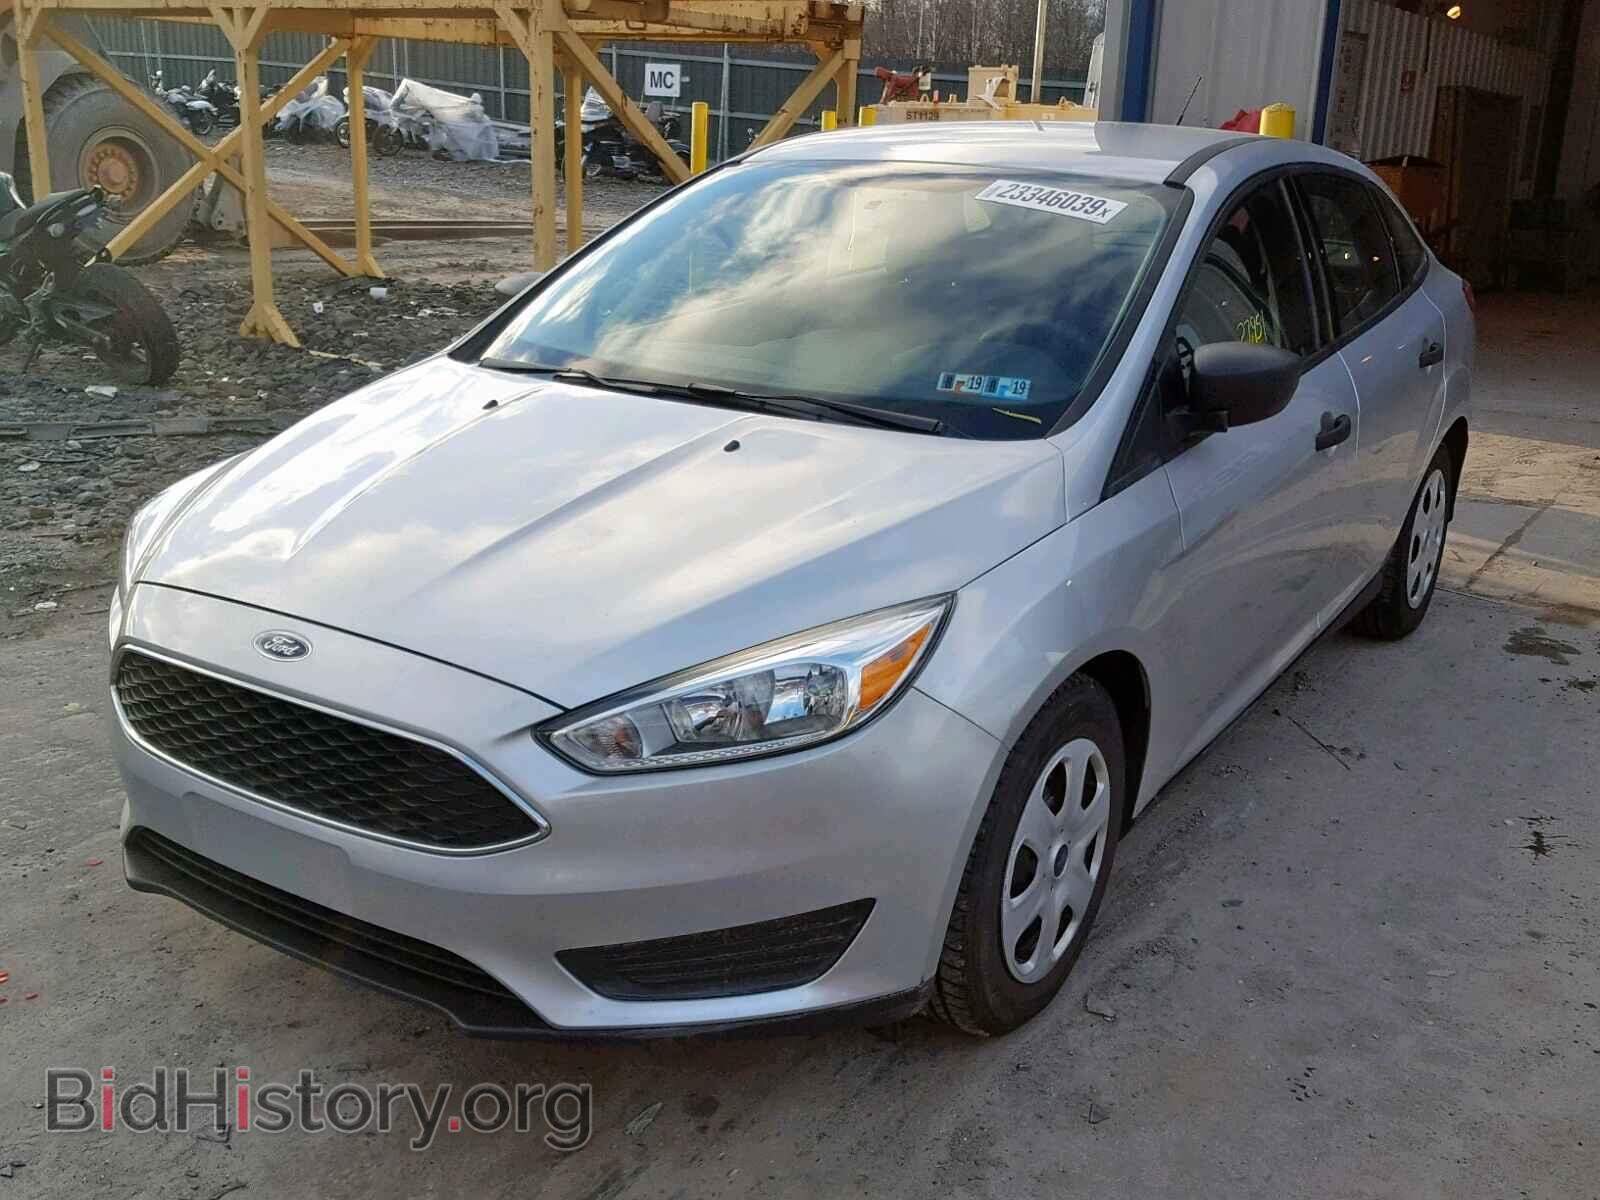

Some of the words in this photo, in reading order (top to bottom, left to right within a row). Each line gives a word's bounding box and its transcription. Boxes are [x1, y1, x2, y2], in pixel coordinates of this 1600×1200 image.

[650, 71, 675, 89] MC
[967, 375, 982, 390] 19
[1011, 380, 1027, 395] 19
[263, 635, 301, 656] Ford
